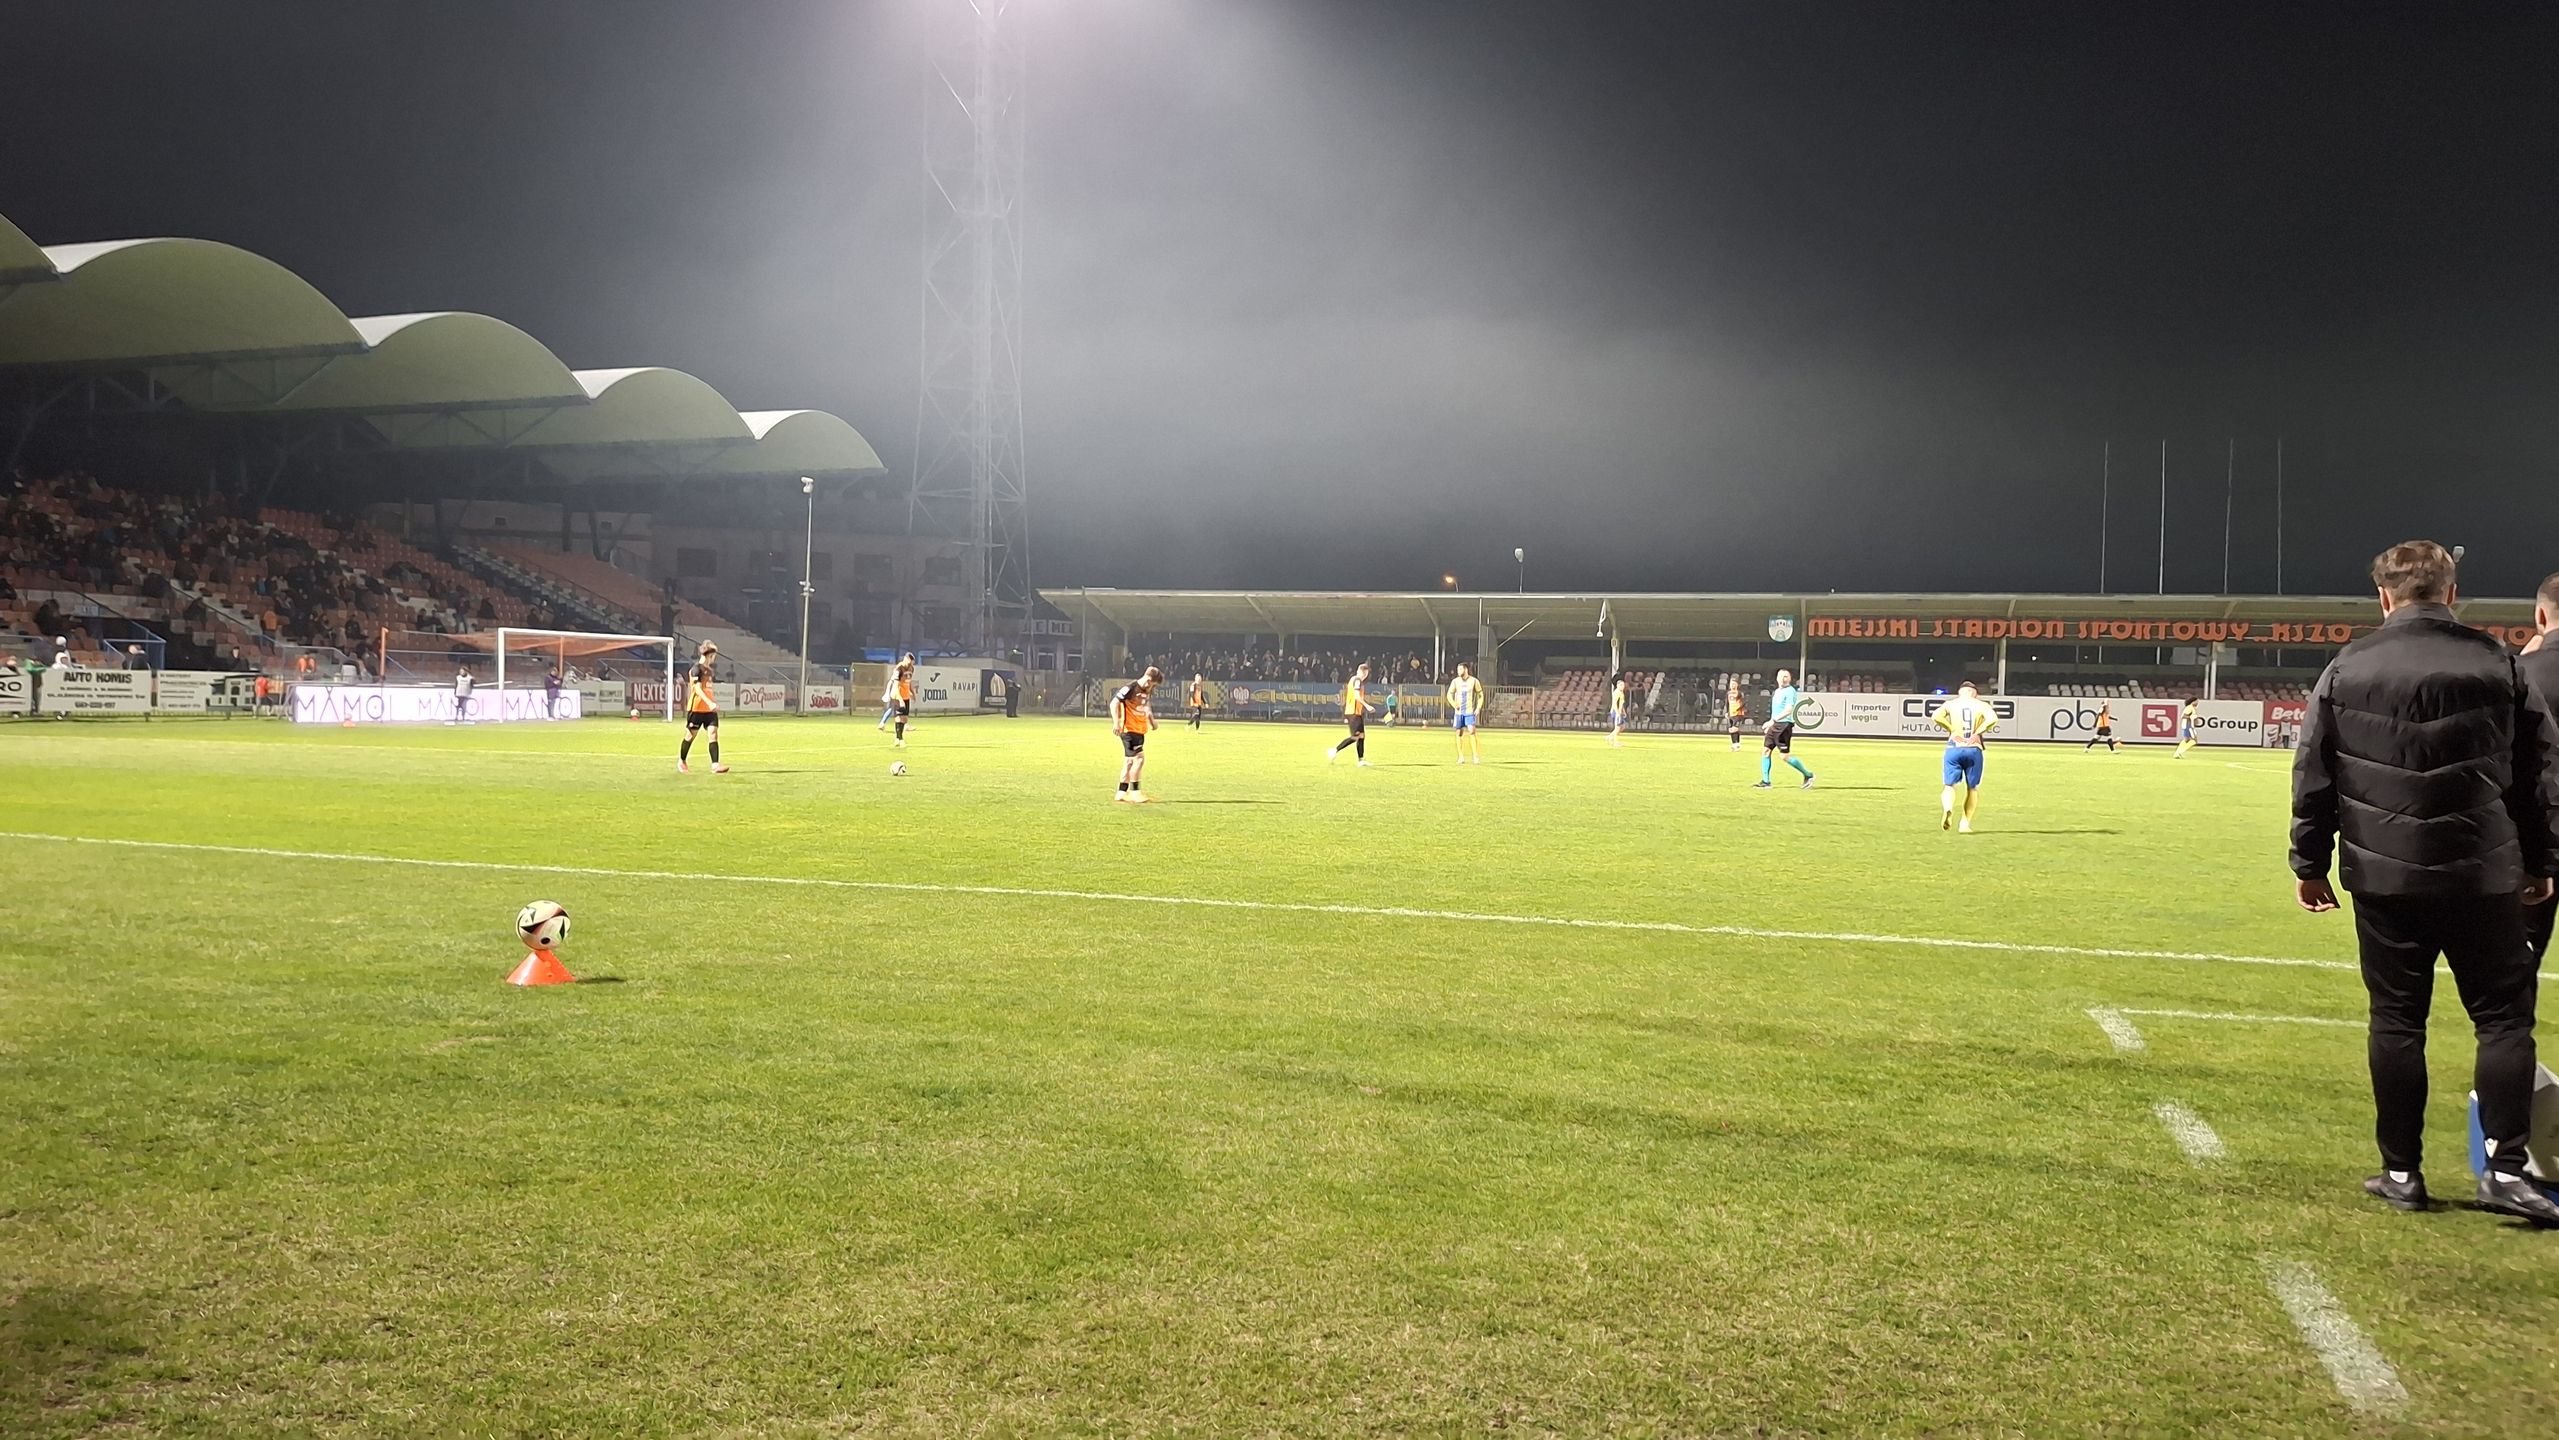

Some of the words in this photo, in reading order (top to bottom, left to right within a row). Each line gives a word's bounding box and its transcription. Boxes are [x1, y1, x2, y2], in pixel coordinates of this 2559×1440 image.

[1808, 618, 1918, 638] MIEJSKI
[1932, 619, 2064, 639] STADION
[2078, 620, 2249, 642] SPORTOWY
[64, 672, 92, 682] AUTO
[1851, 704, 1891, 713] Importer
[1851, 714, 1878, 723] węgla
[1902, 724, 1930, 732] HUTA
